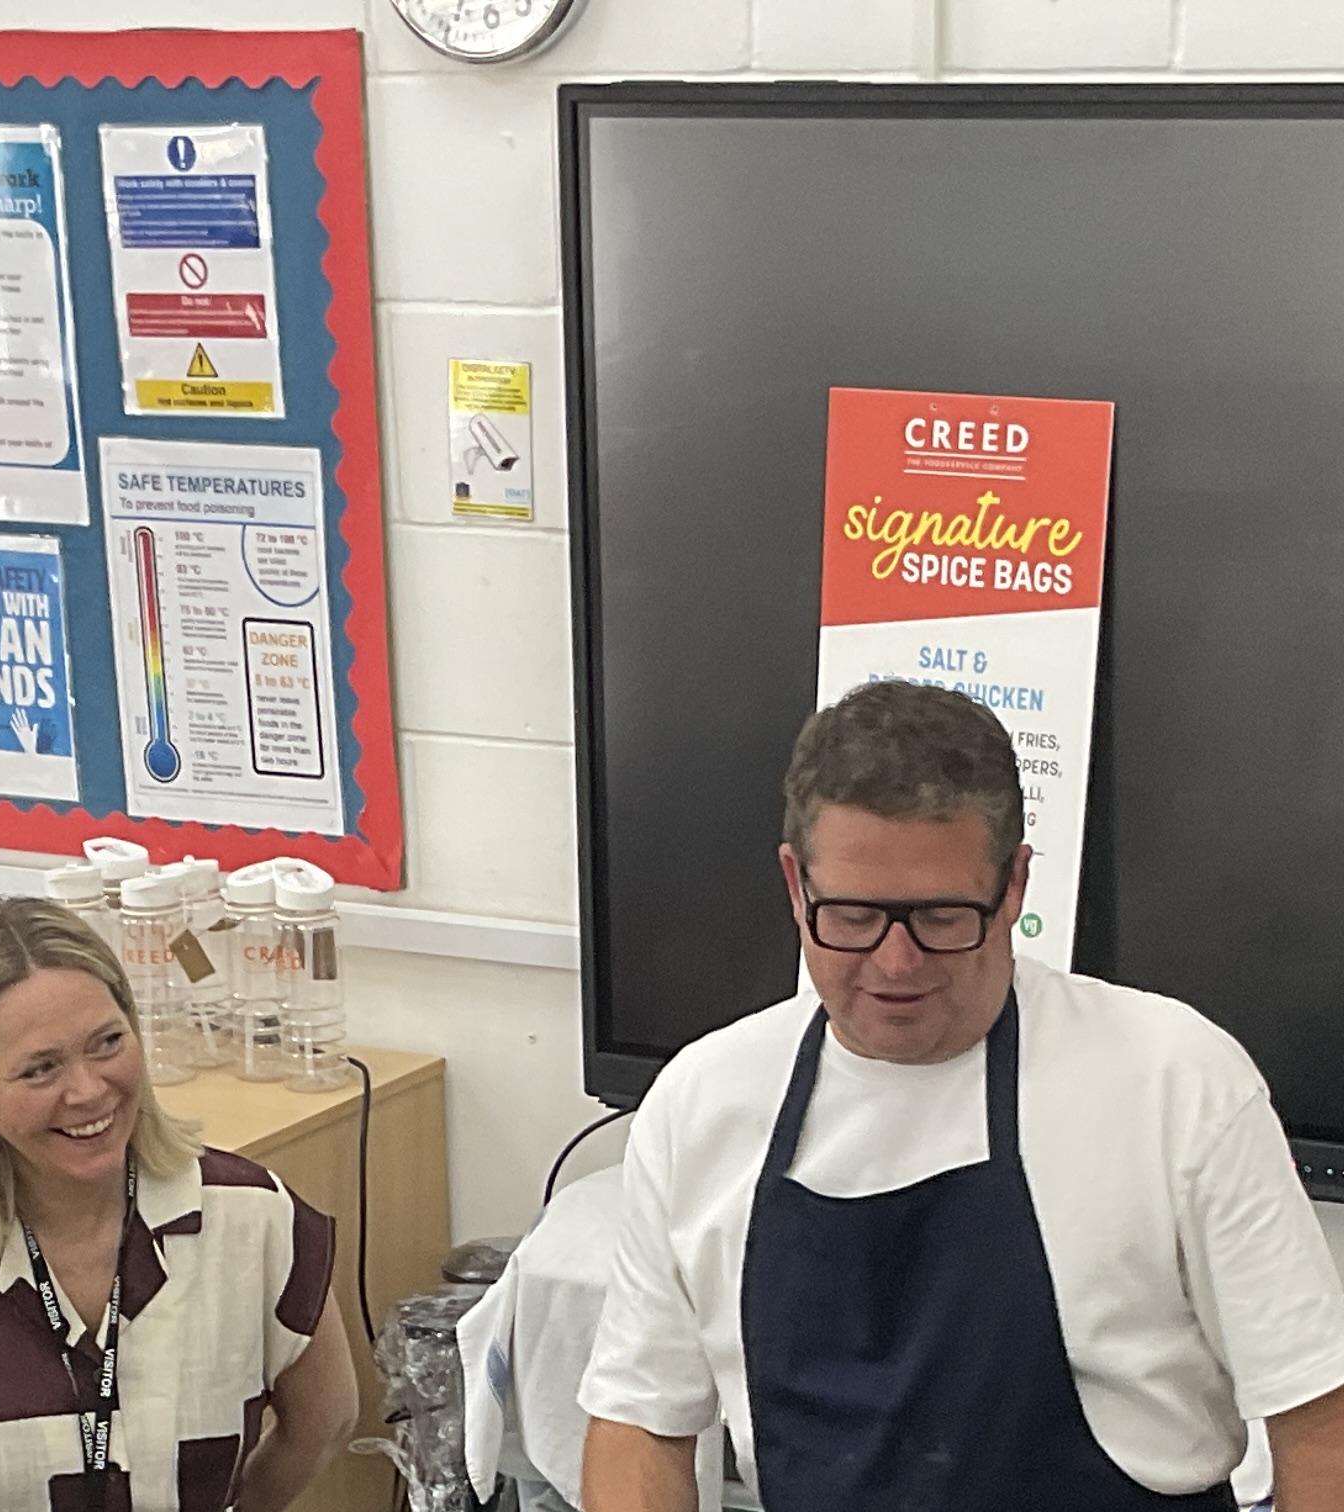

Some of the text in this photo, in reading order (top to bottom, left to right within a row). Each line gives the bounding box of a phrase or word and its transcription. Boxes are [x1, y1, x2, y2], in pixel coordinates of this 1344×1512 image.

[181, 383, 226, 396] Caution
[905, 417, 1029, 453] CREED
[118, 472, 306, 499] SAFE TEMPERATURES
[119, 497, 256, 518] To prevent food poisoning
[844, 490, 1083, 579] signature
[901, 552, 1073, 595] SPICE BAGS
[2, 590, 50, 619] WITH
[249, 631, 308, 649] DANGER
[261, 653, 299, 668] ZONE
[918, 645, 988, 674] SALT &
[1018, 731, 1061, 752] FRIES,
[39, 1280, 62, 1330] VISITOR
[99, 1347, 115, 1398] VISITOR
[94, 1420, 109, 1470] VISITOR
